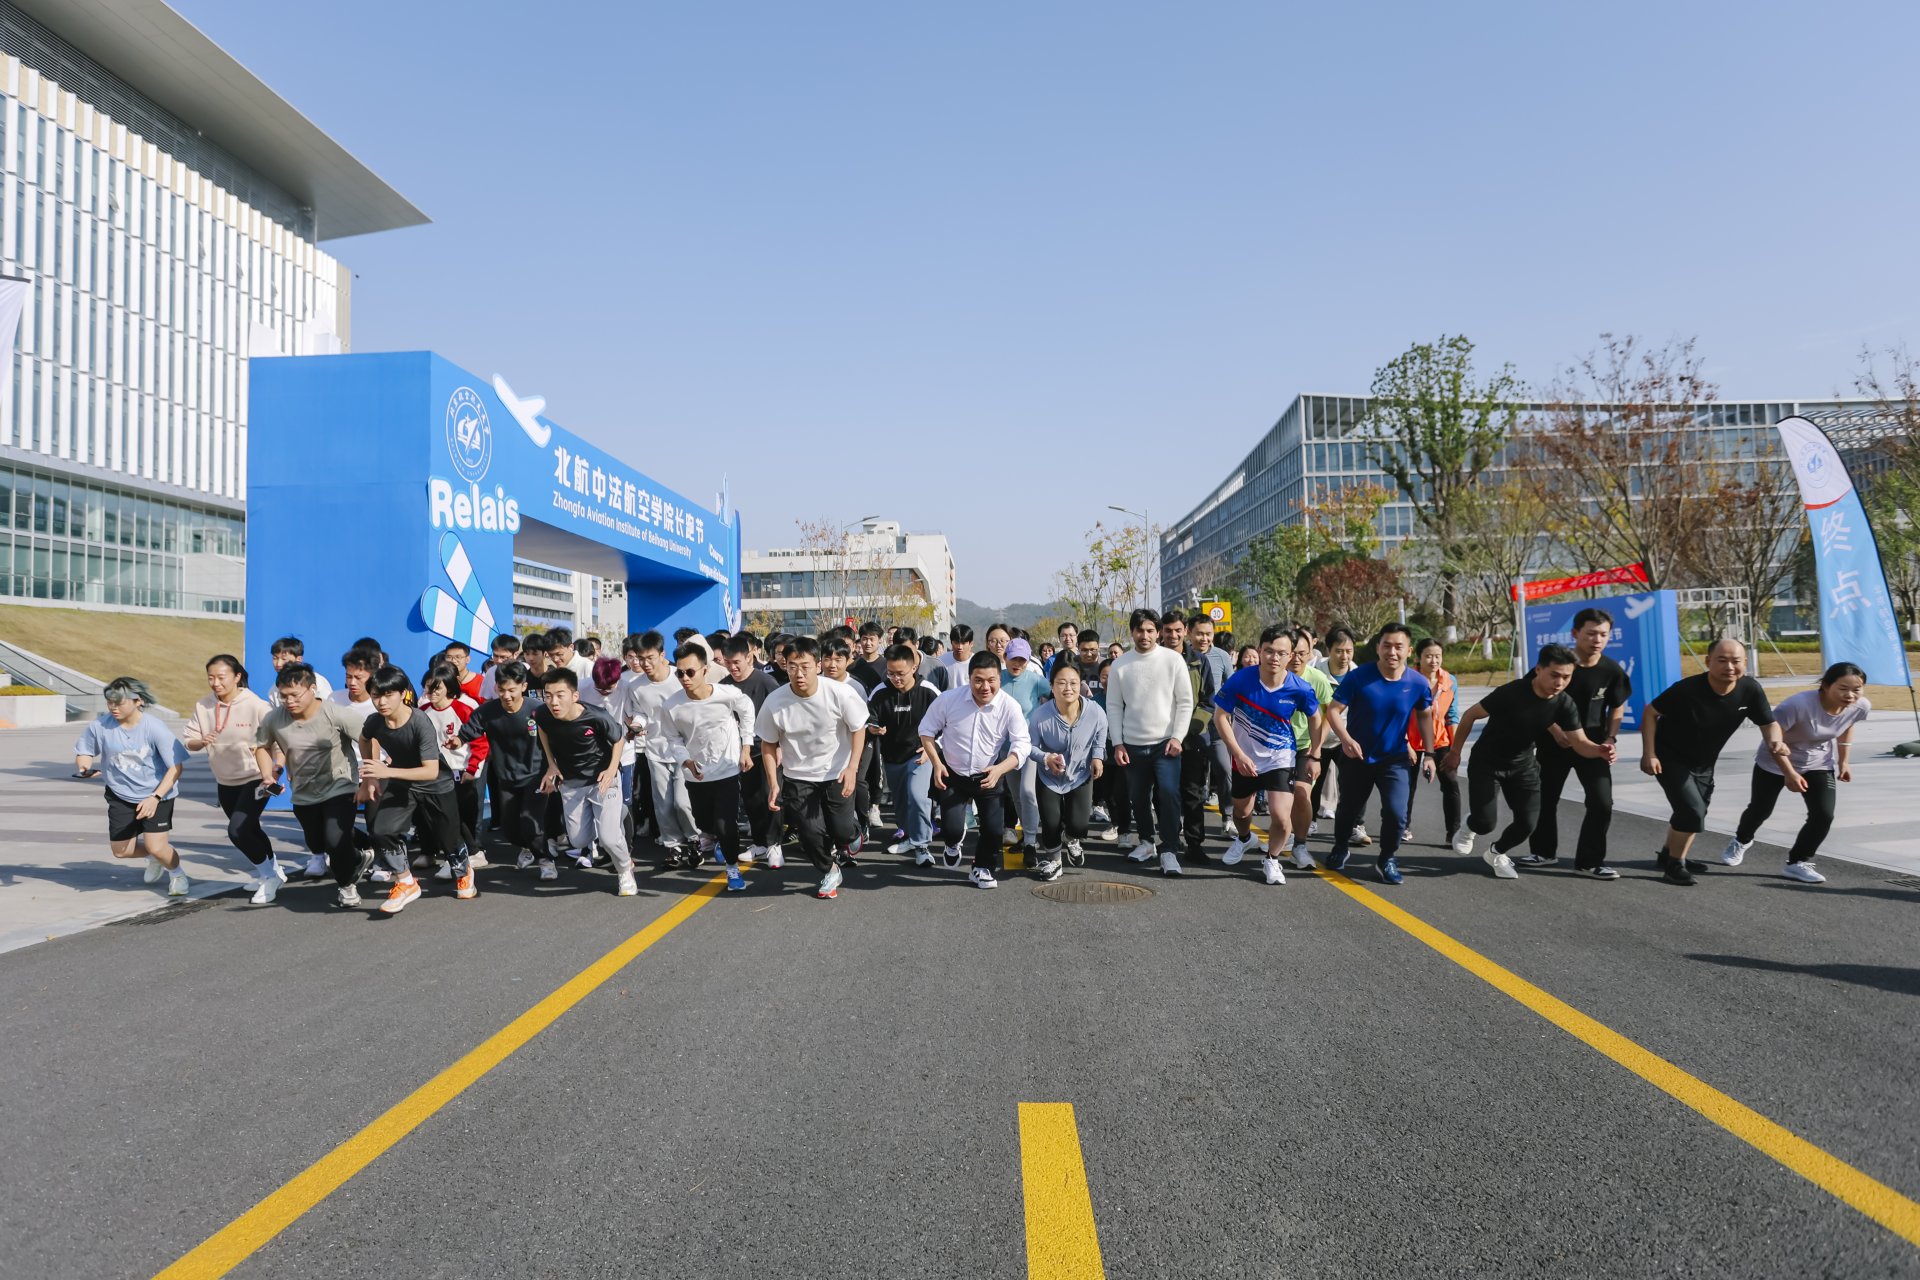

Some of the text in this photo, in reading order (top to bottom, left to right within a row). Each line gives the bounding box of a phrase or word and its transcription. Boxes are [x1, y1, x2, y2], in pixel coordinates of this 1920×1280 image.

[430, 479, 520, 532] Relais
[553, 490, 692, 560] Zhongfa Aviation Institute of Beihang University
[554, 445, 704, 544] 北航中法航空学院长跑节
[1820, 511, 1872, 620] 终点
